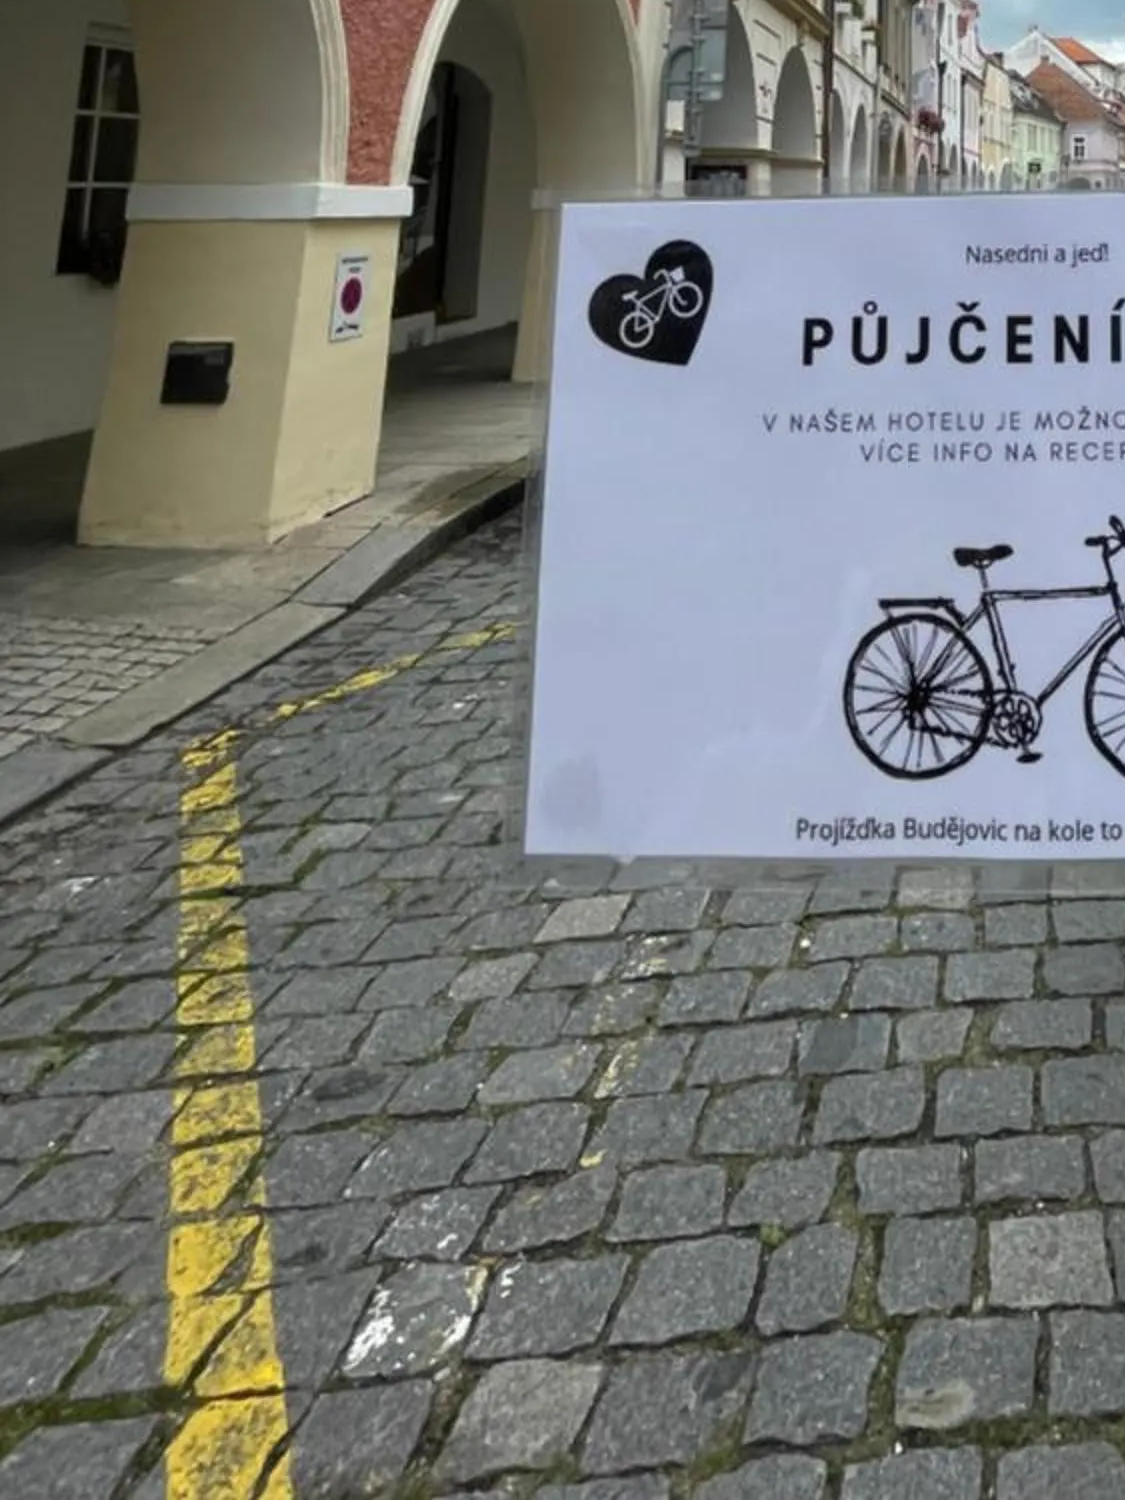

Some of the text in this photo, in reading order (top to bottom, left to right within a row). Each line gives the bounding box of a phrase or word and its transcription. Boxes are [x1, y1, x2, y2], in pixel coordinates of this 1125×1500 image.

[966, 244, 1048, 264] Nasedni
[1054, 248, 1066, 263] a
[763, 414, 777, 432] V
[790, 408, 876, 434] NAŠEM
[887, 411, 984, 432] HOTELU
[996, 411, 1020, 431] JE
[860, 438, 919, 463] VÍCE
[934, 442, 992, 462] INFO
[1005, 443, 1037, 461] NA
[796, 817, 896, 846] Projížďka
[903, 816, 1007, 846] Budějovic
[1014, 824, 1041, 842] na
[1048, 818, 1095, 842] kole
[1100, 821, 1123, 841] to
